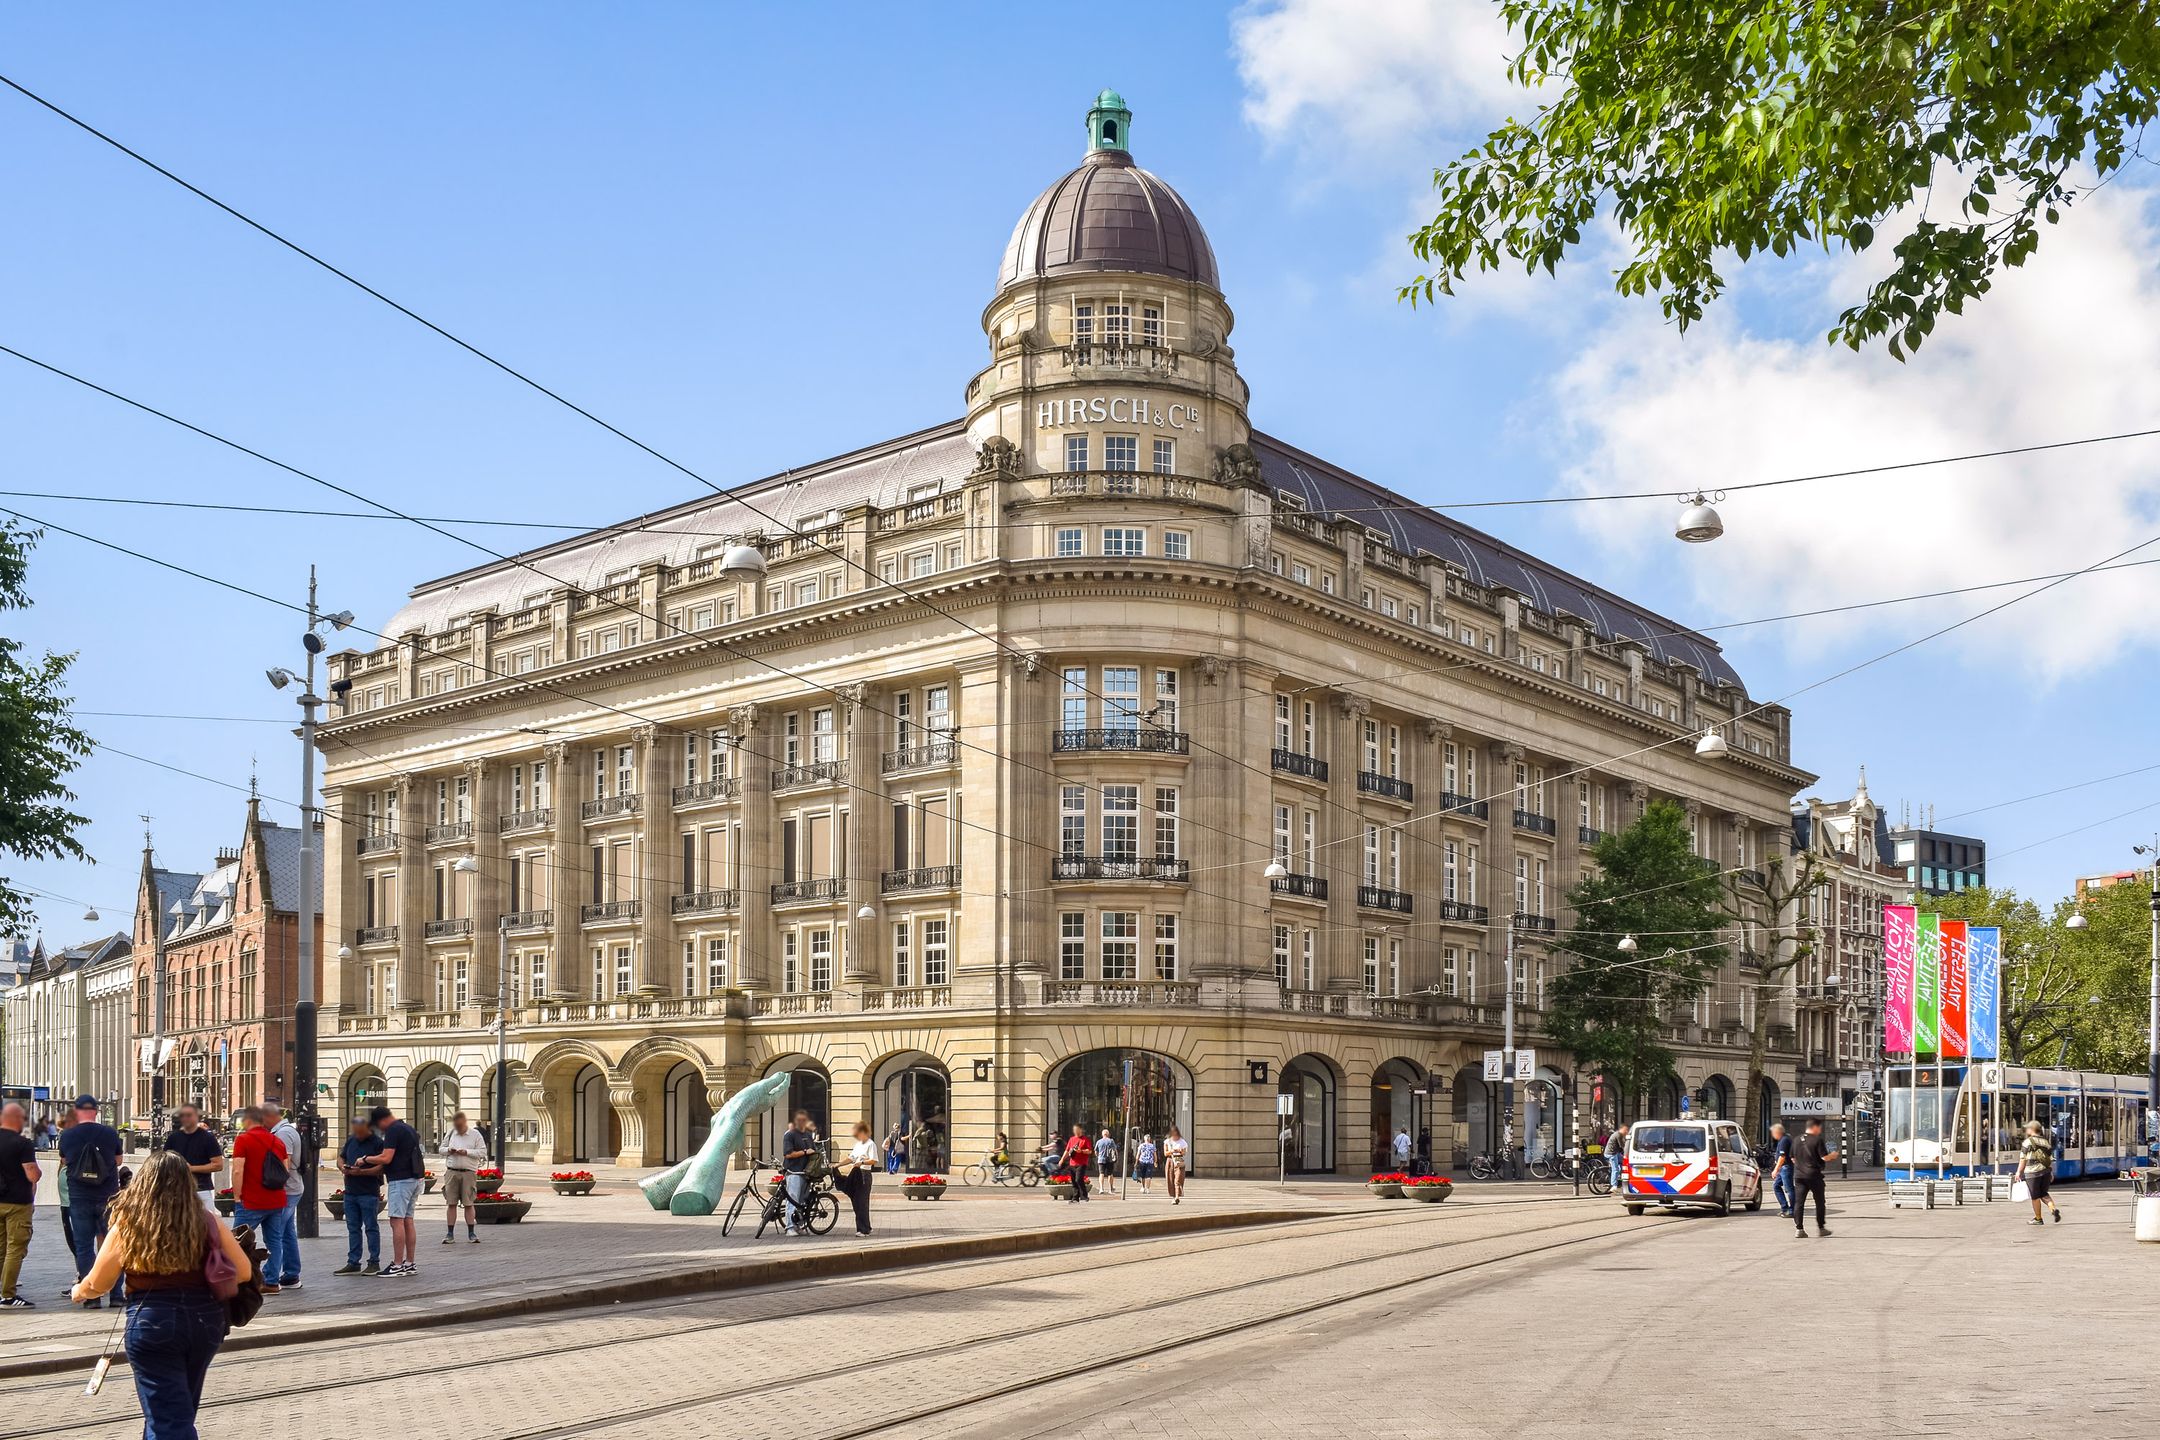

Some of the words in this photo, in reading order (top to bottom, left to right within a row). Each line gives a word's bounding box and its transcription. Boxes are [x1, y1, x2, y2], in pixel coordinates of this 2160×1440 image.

[1038, 397, 1149, 428] HIRSCH
[1153, 408, 1165, 428] &
[1922, 1072, 1930, 1082] 2
[1802, 1100, 1822, 1110] WC
